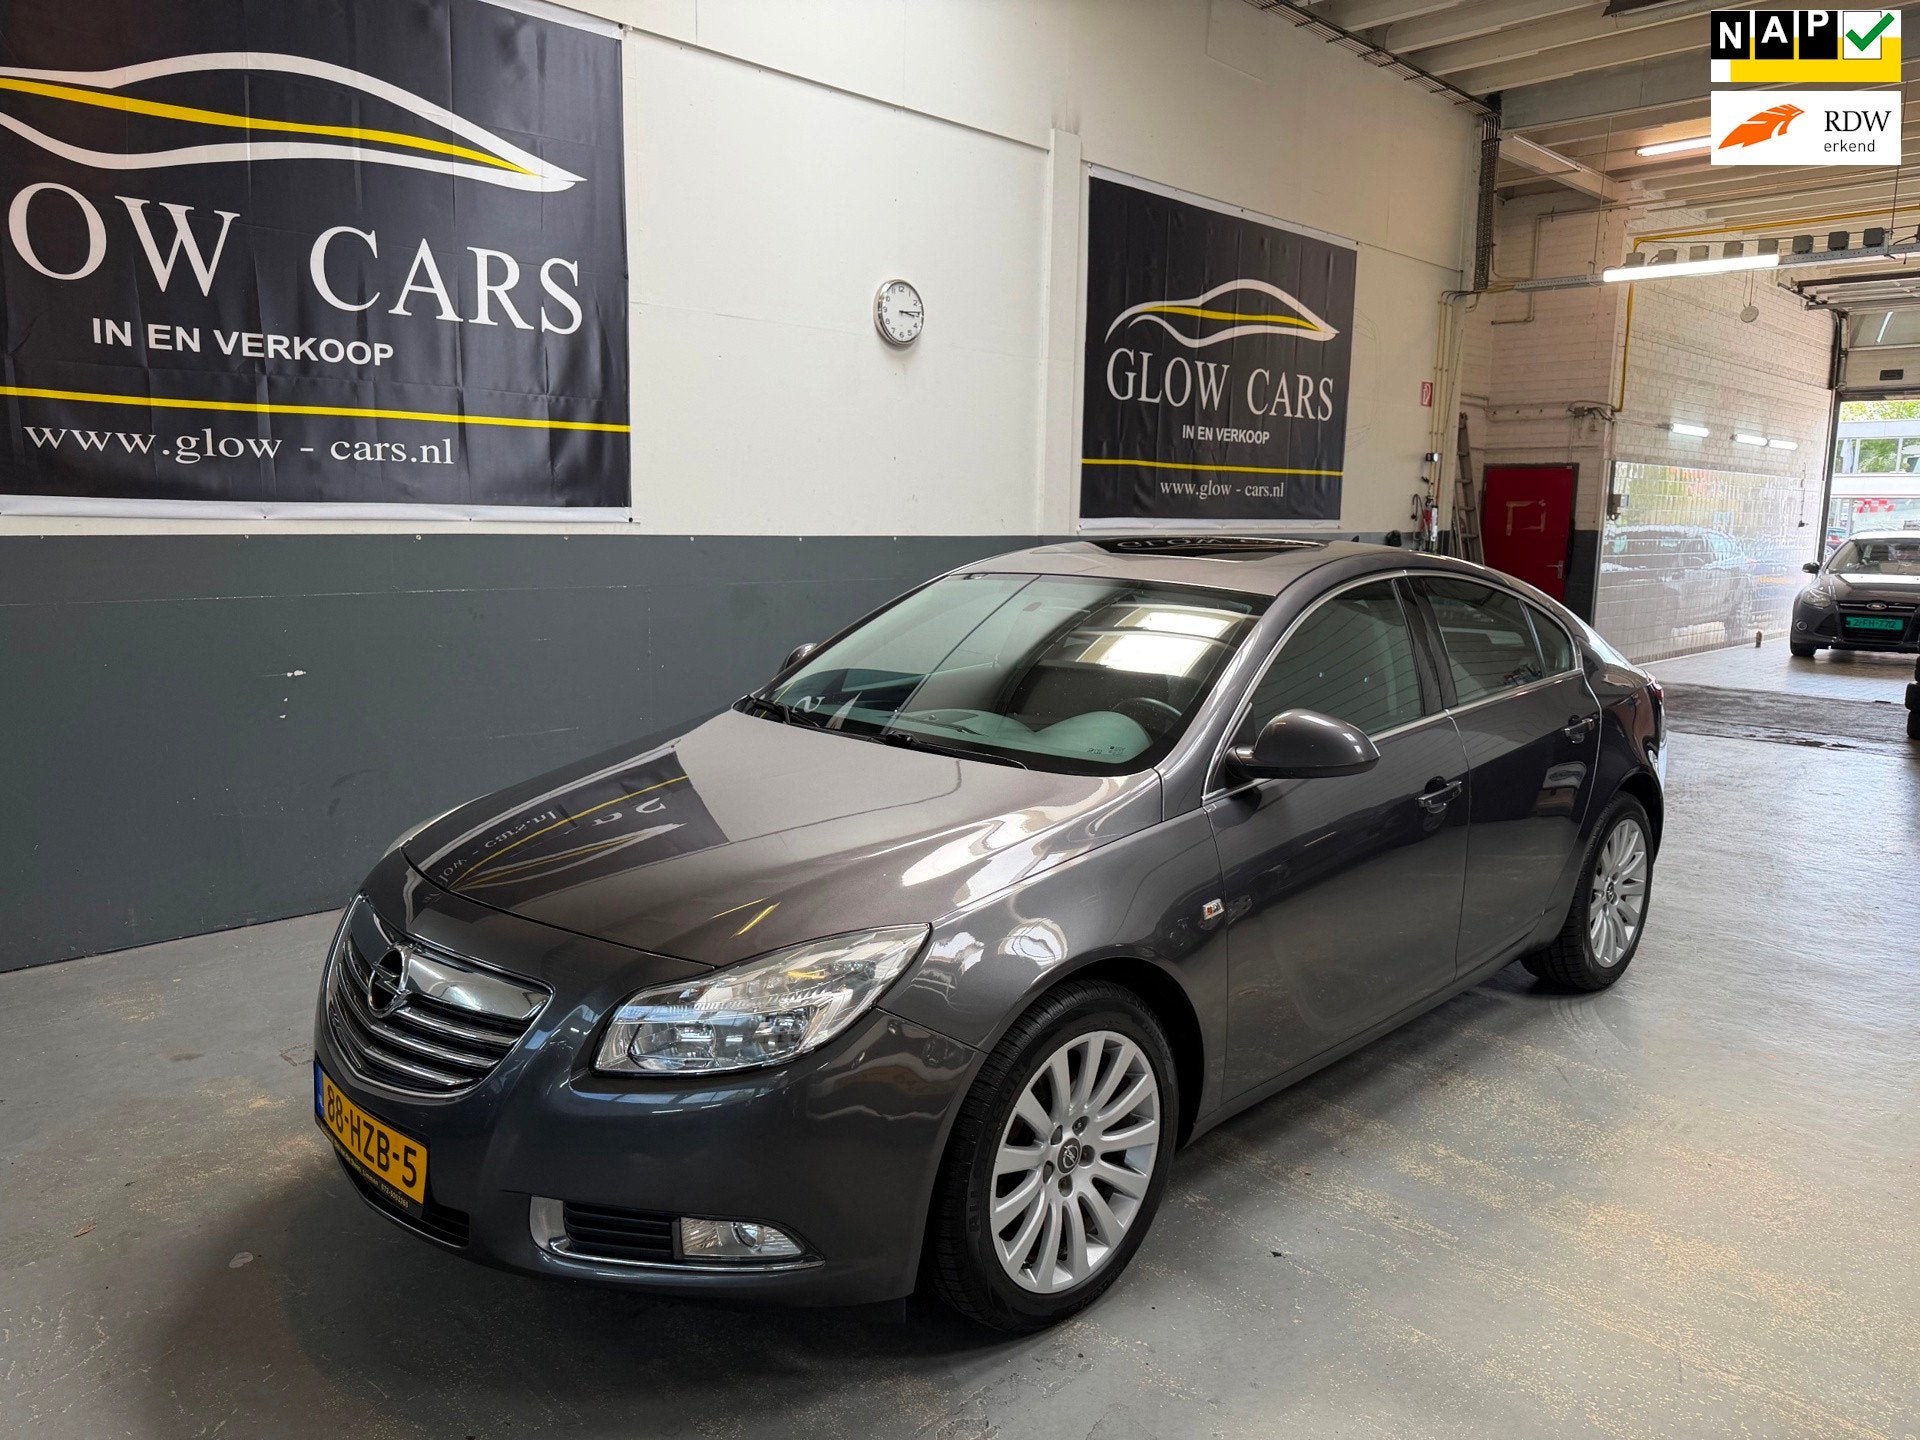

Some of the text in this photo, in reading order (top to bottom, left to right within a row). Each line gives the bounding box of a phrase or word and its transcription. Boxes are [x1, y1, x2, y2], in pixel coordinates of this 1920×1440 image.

[8, 182, 583, 335] OW CARS
[92, 317, 394, 366] IN EN VERKOOP
[1106, 347, 1334, 422] GLOW CARS
[23, 425, 283, 464] www.glow
[330, 437, 455, 465] cars.nl
[1182, 424, 1270, 445] IN EN VERKOOP
[1160, 480, 1232, 500] www.glow
[1244, 482, 1284, 498] cars.nl
[327, 1084, 417, 1188] 88-HZB-5
